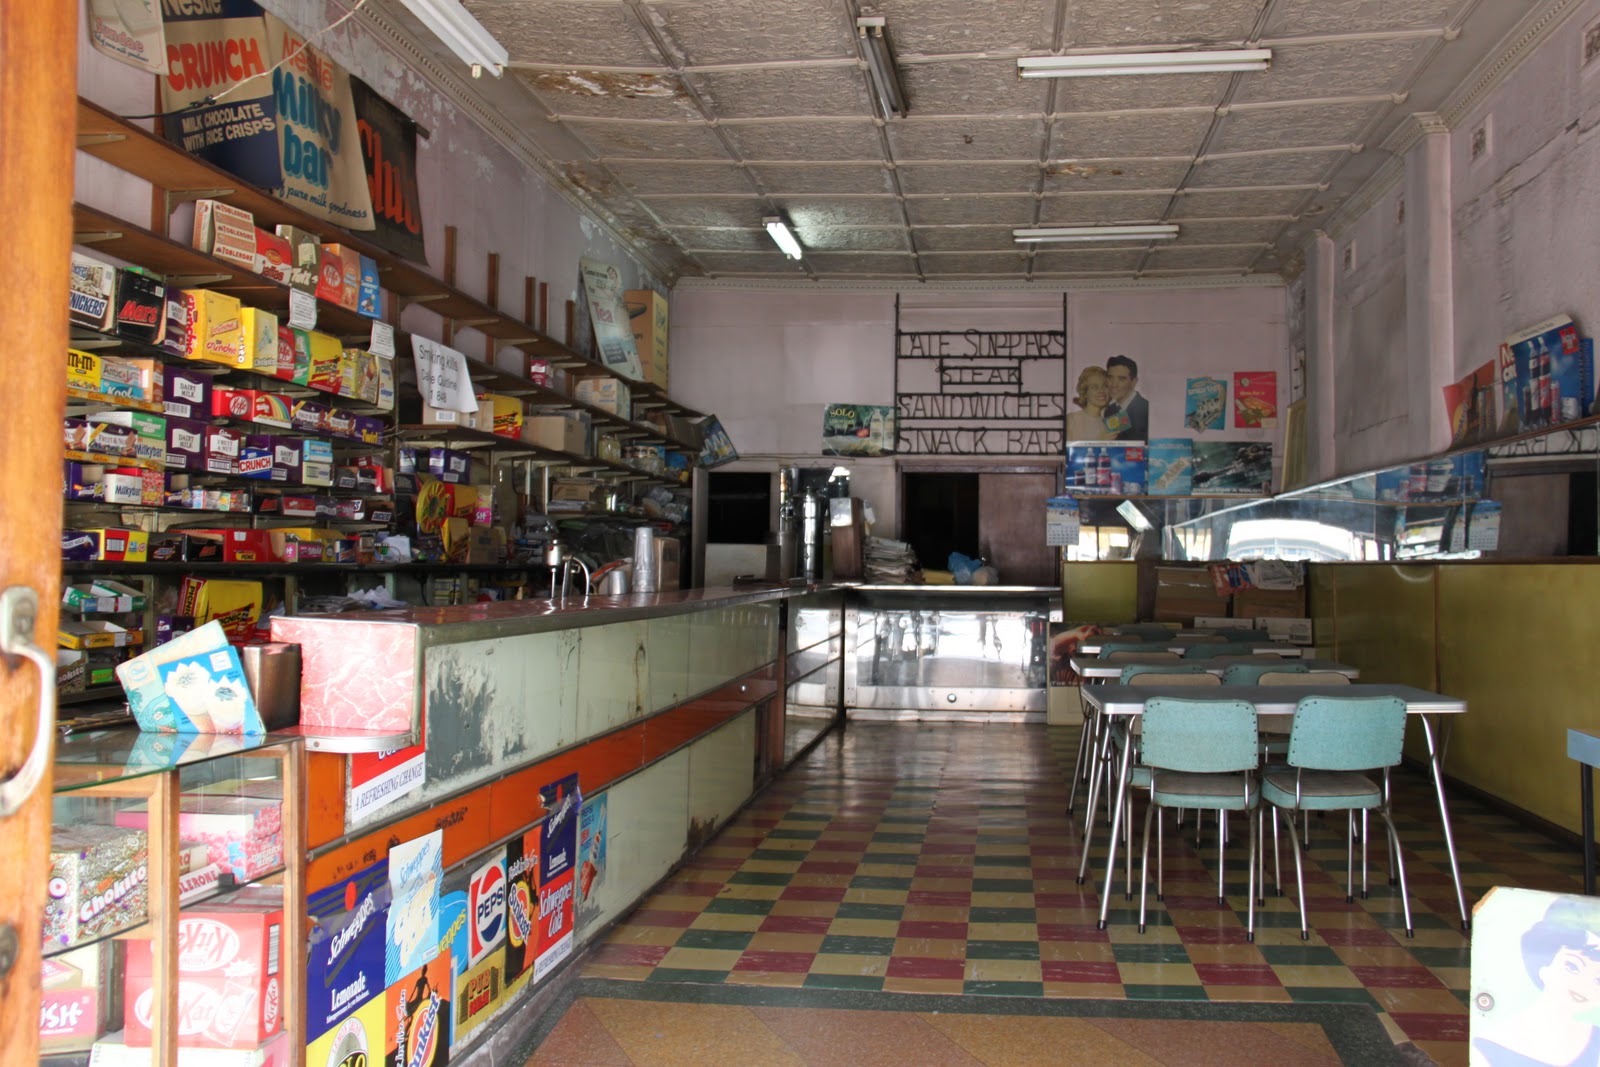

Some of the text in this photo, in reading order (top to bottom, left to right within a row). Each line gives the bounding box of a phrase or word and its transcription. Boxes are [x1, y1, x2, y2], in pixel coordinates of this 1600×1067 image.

[166, 37, 266, 92] CRUNCH
[182, 103, 265, 135] MILK CHOCOLATE
[272, 65, 342, 155] Milky
[183, 117, 276, 152] WITH RICE CRISPS
[283, 124, 334, 191] bar
[286, 187, 308, 202] pure
[309, 193, 327, 208] milk
[328, 202, 368, 218] goodness
[222, 246, 253, 262] TOBLERONE
[70, 291, 105, 317] NICKERS
[118, 300, 158, 324] Mars
[592, 301, 614, 324] Tea
[206, 341, 237, 355] Crunchie
[963, 329, 1066, 358] SUPPERS
[315, 362, 337, 375] PICNIC
[941, 367, 1020, 384] STEAK
[179, 382, 196, 393] DAIRY
[181, 389, 196, 399] MILK
[829, 408, 856, 419] SOLO
[898, 394, 1065, 419] SANDWICHES
[178, 433, 195, 442] DAIRY
[180, 440, 193, 449] MILK
[217, 439, 233, 447] FRUIT
[361, 428, 379, 444] Twirl
[898, 429, 1064, 455] SNACK BAR
[135, 443, 163, 459] Milkybar
[240, 457, 272, 472] CRUNCH
[114, 484, 142, 498] Milkybar
[360, 775, 400, 809] REFRESHING
[399, 762, 424, 787] CHANGE
[547, 793, 572, 839] Schweppes
[400, 838, 431, 890] Schweppes
[79, 865, 147, 924] Chokito
[477, 882, 507, 925] PEPSI
[538, 880, 573, 921] Schweppes
[508, 882, 531, 946] Sunkist
[548, 910, 564, 938] Cola
[327, 891, 376, 966] Schweppes
[331, 970, 366, 1012] Lemonade
[468, 968, 491, 1000] PUB
[265, 984, 278, 1026] KitKat
[396, 988, 408, 1020] Sun
